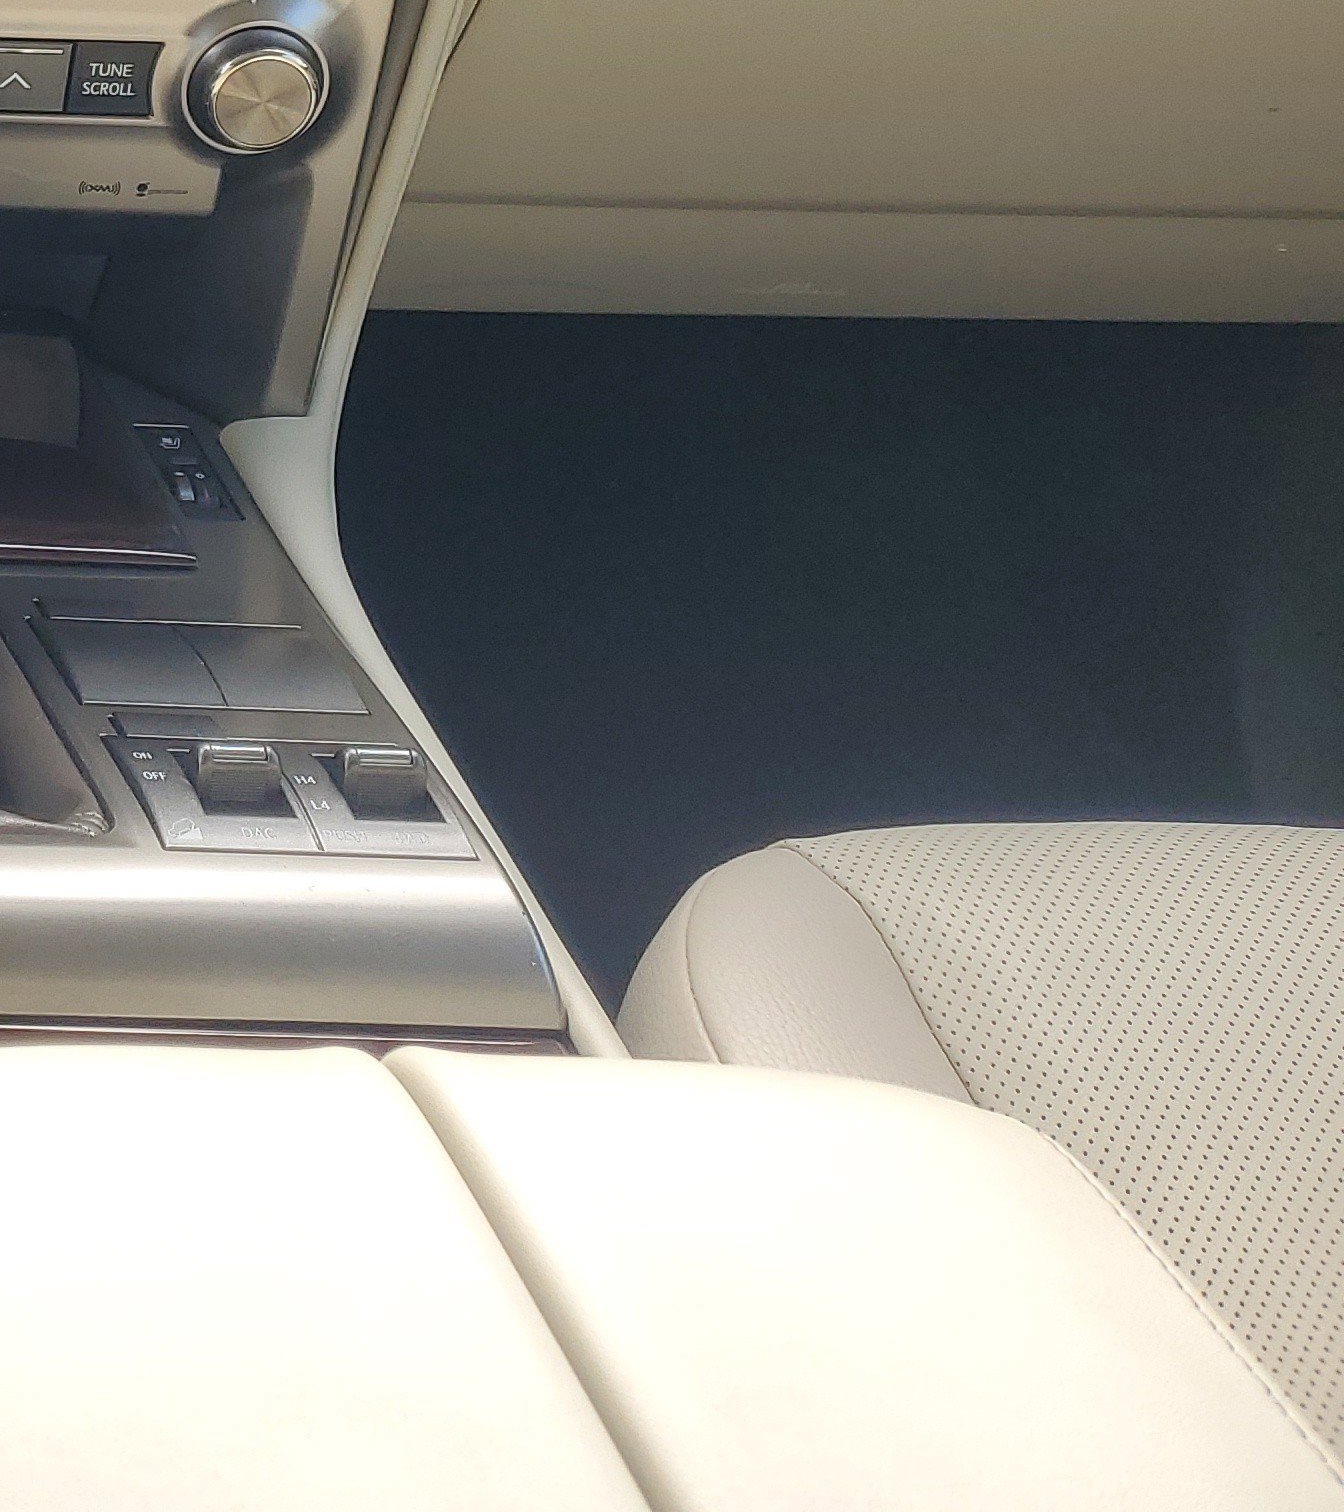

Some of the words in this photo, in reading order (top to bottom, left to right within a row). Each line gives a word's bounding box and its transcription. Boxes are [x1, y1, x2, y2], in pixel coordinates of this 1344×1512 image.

[89, 62, 135, 78] TUNE
[81, 81, 137, 96] SCROLL
[142, 771, 167, 781] OFF
[294, 774, 317, 785] H4
[310, 799, 331, 811] L4
[241, 826, 277, 839] DAC
